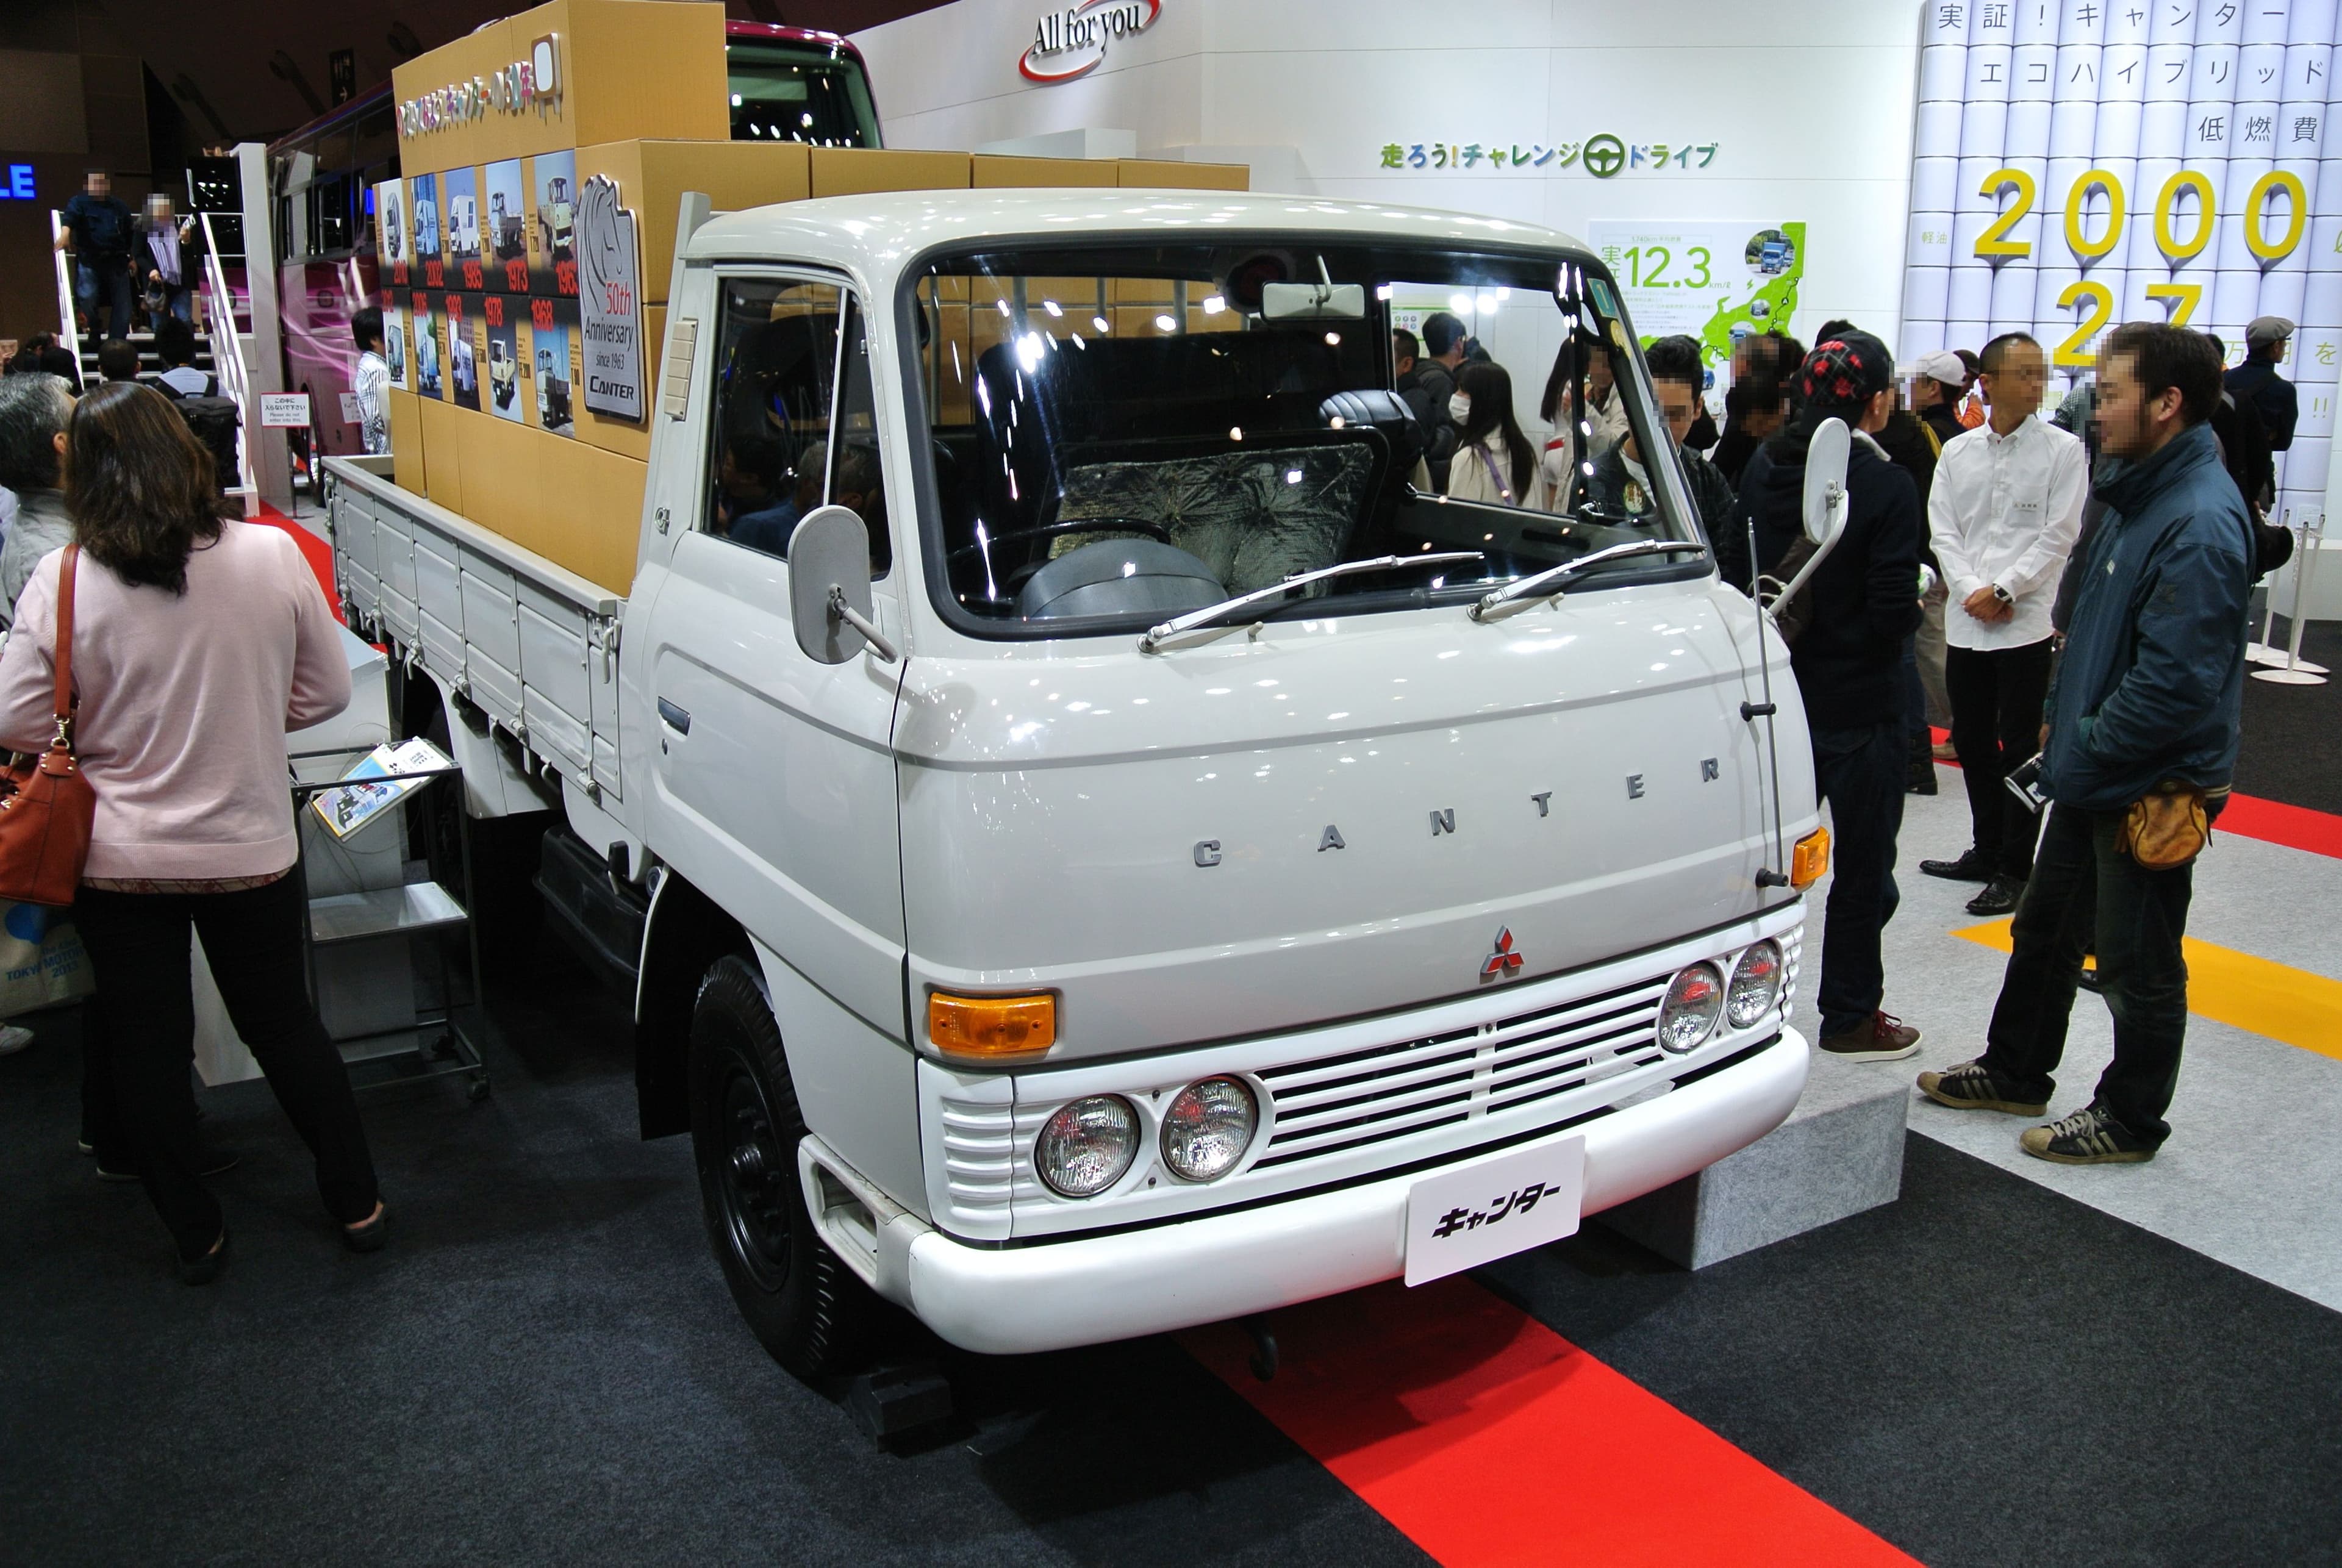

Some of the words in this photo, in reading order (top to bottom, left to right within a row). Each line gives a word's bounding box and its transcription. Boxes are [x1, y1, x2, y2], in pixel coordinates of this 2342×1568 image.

[1033, 13, 1060, 55] All
[1066, 9, 1096, 46] for
[1101, 5, 1140, 52] you
[1980, 59, 2323, 84] エコハイブリッド
[2199, 116, 2318, 143] 低燃費
[1630, 142, 1719, 168] ドライブ
[1974, 168, 2307, 259] 2000
[506, 260, 529, 292] 1973
[1624, 246, 1711, 288] 12.3
[484, 296, 503, 328] 1978
[531, 299, 554, 332] 1968
[606, 281, 631, 316] 50th
[584, 316, 634, 352] Anniversary
[596, 353, 609, 368] since
[611, 353, 625, 370] 1963
[1194, 757, 1721, 868] CANTER
[1431, 1182, 1561, 1239] キャンター
